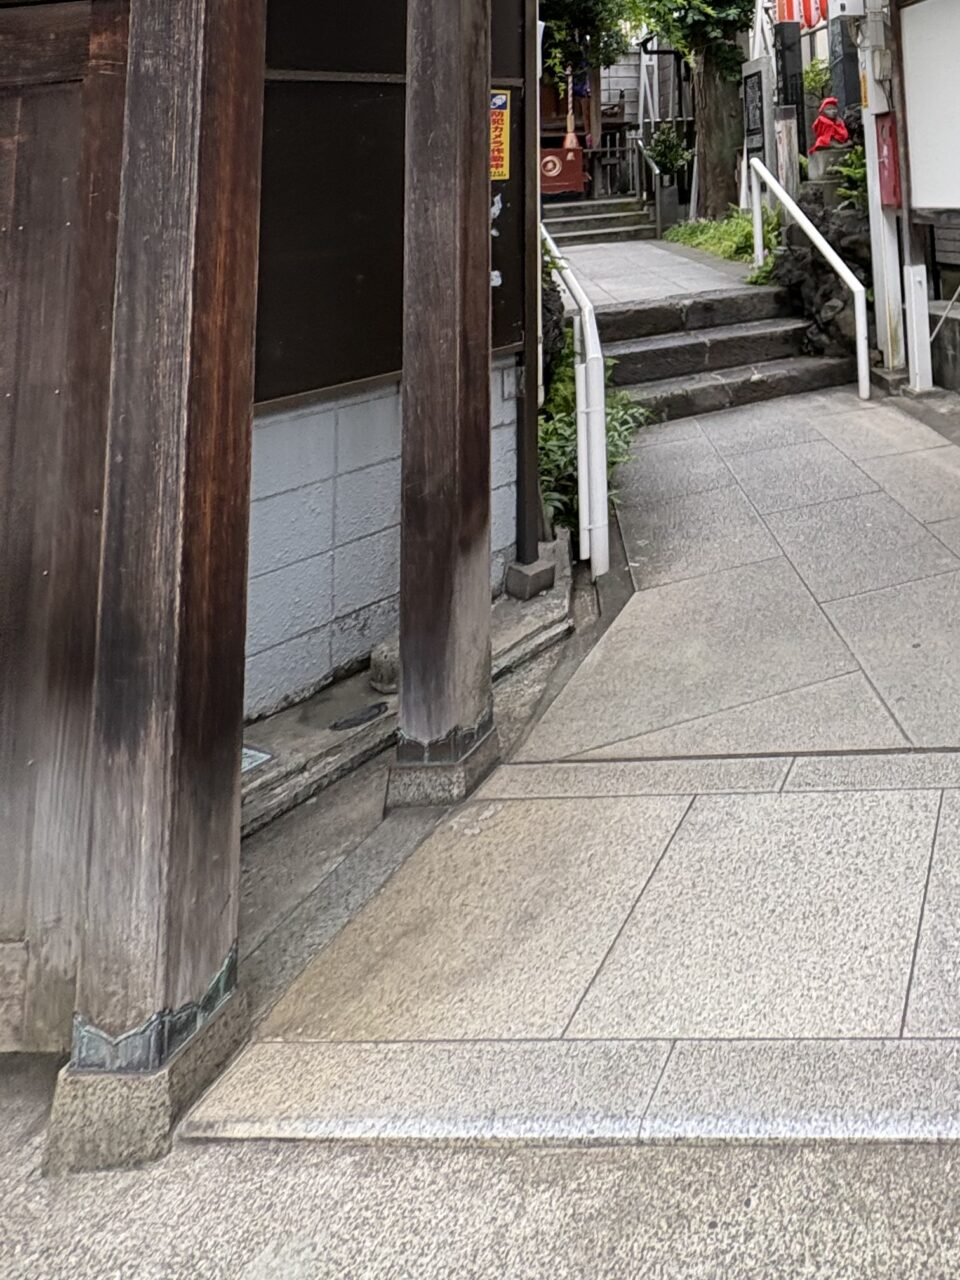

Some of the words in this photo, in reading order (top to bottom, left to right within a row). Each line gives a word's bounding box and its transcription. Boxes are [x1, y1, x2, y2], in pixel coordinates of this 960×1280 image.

[490, 111, 504, 171] 防犯カメラ作動中
